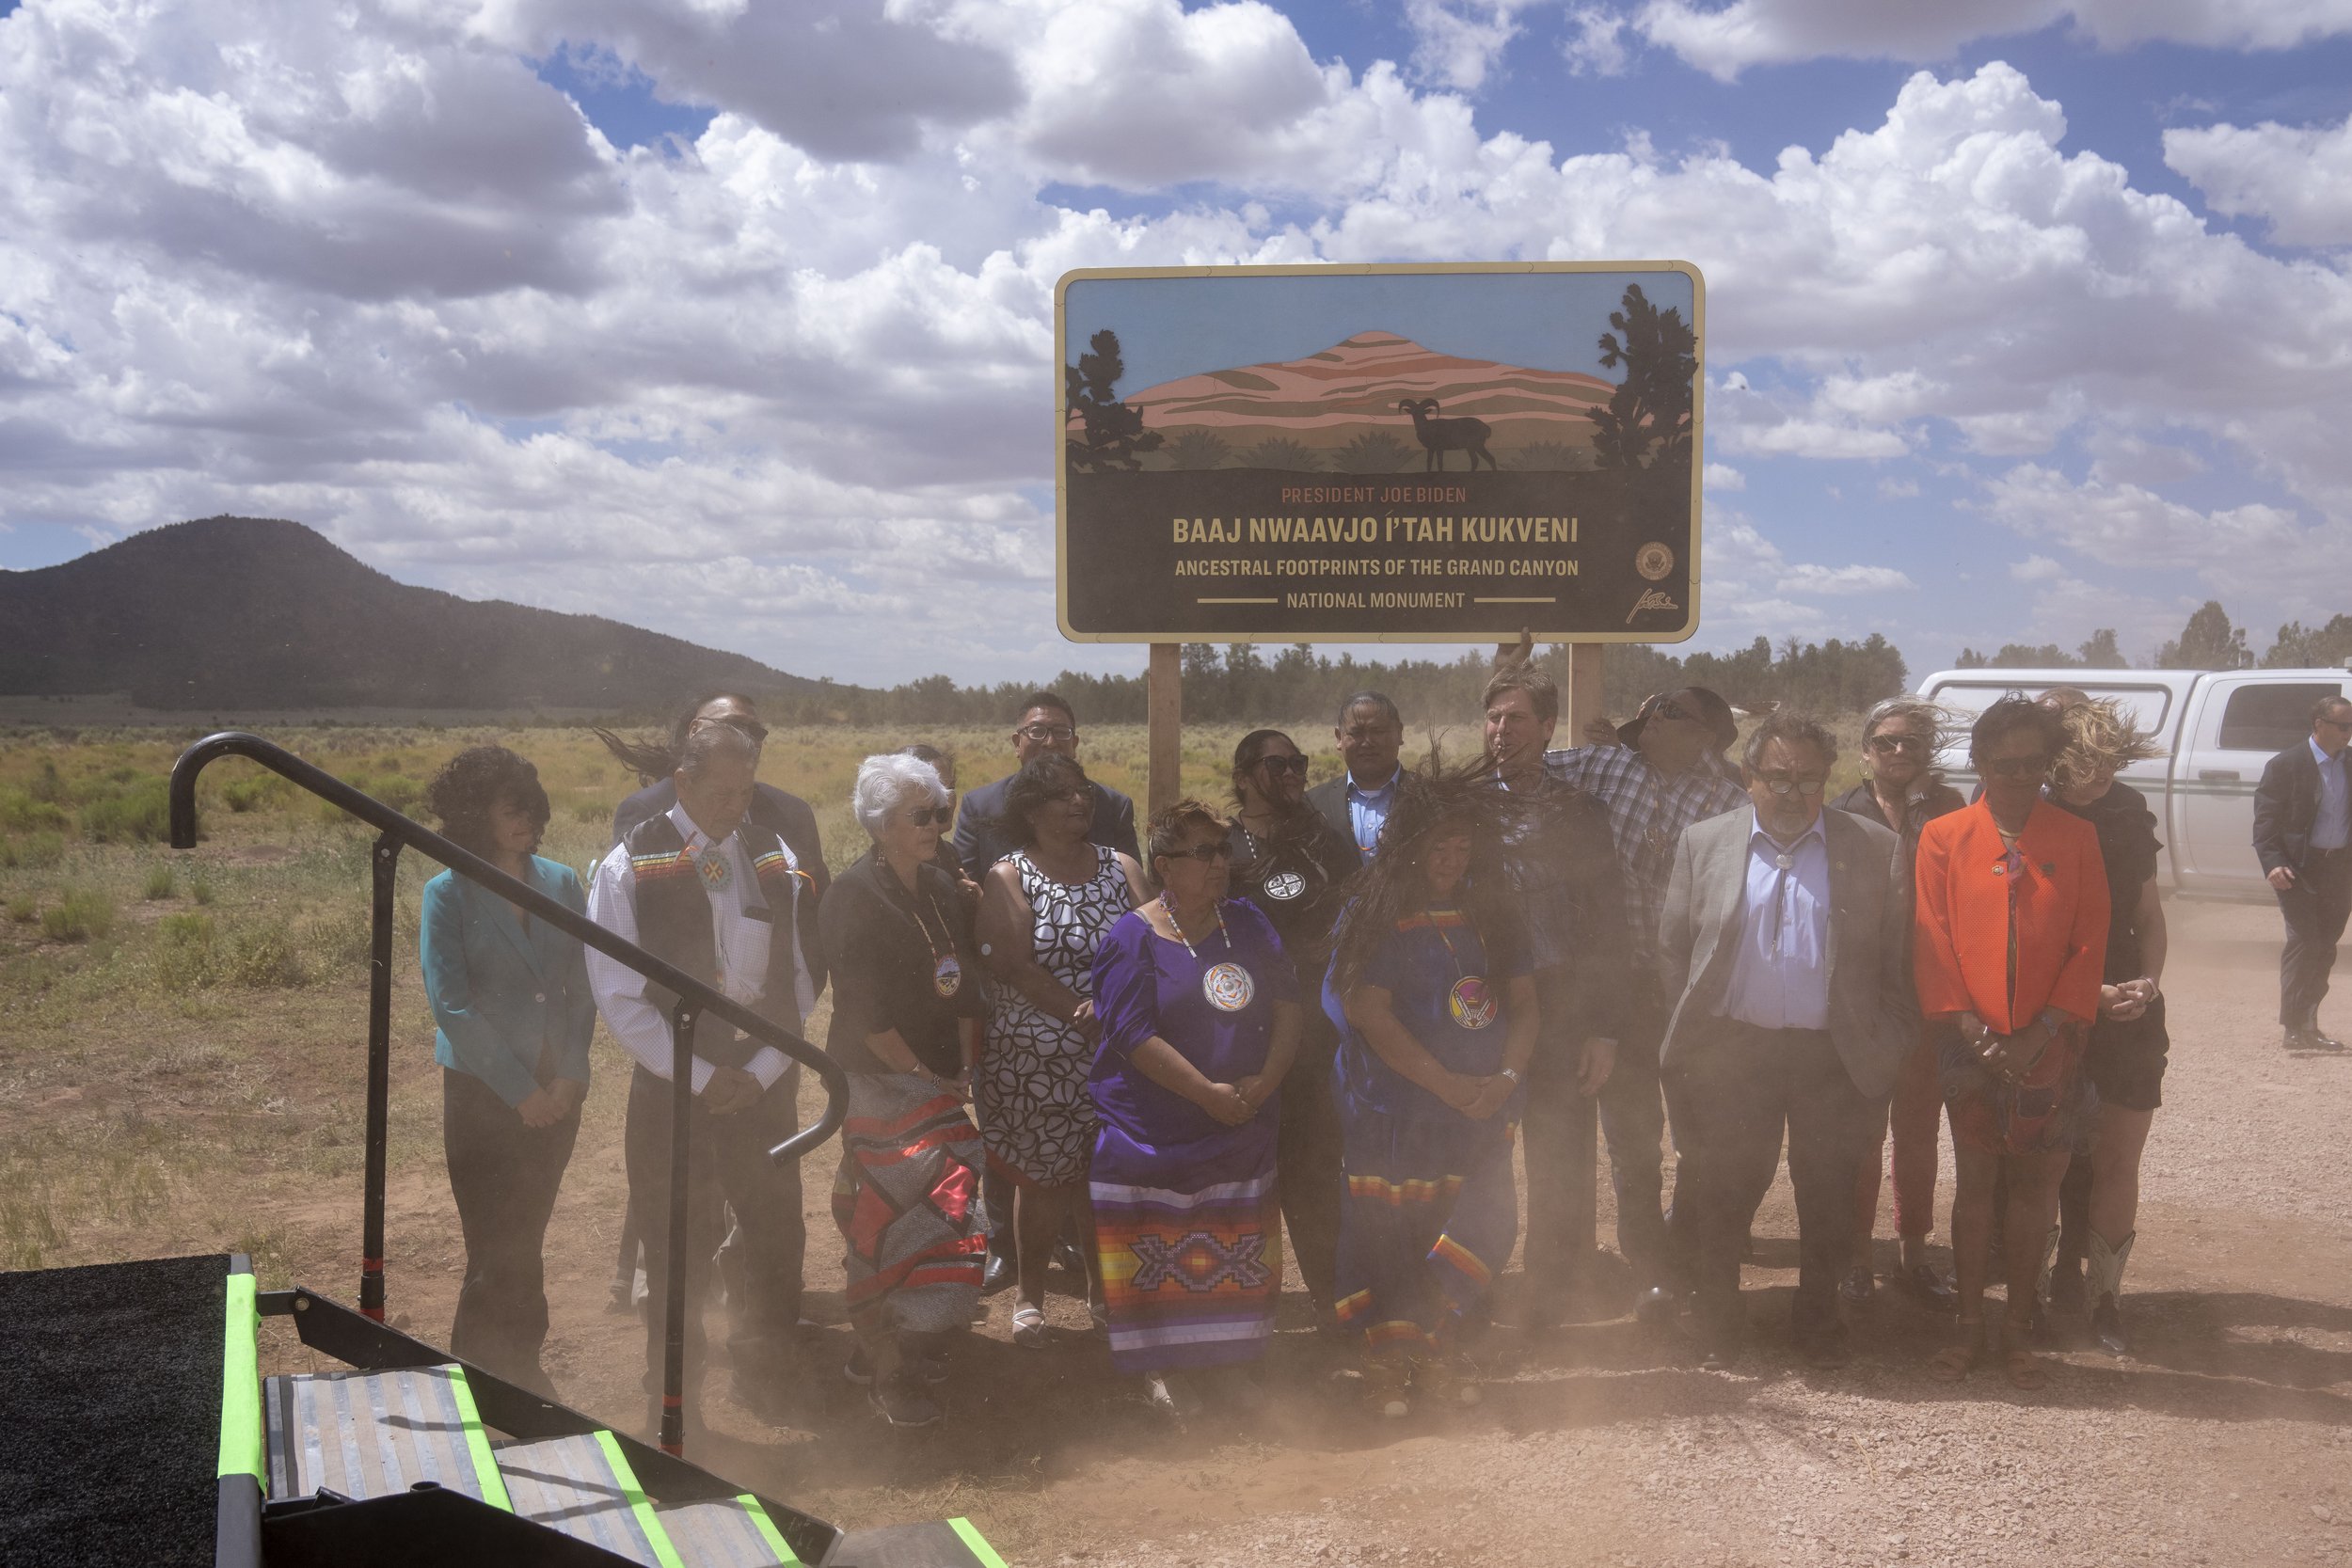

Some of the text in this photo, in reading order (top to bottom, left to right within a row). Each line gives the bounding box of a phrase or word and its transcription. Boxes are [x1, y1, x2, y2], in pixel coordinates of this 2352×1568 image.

[1281, 487, 1466, 503] PRESIDENT JOE BIDEN
[1173, 517, 1241, 544] BAAJ
[1248, 516, 1378, 543] NWAAVJO
[1461, 516, 1579, 543] KUKVENI
[1175, 559, 1579, 577] ANCESTRAL FOOTPRINTS OF THE GRAND CANYON
[1287, 592, 1466, 609] NATIONAL MONUMENT
